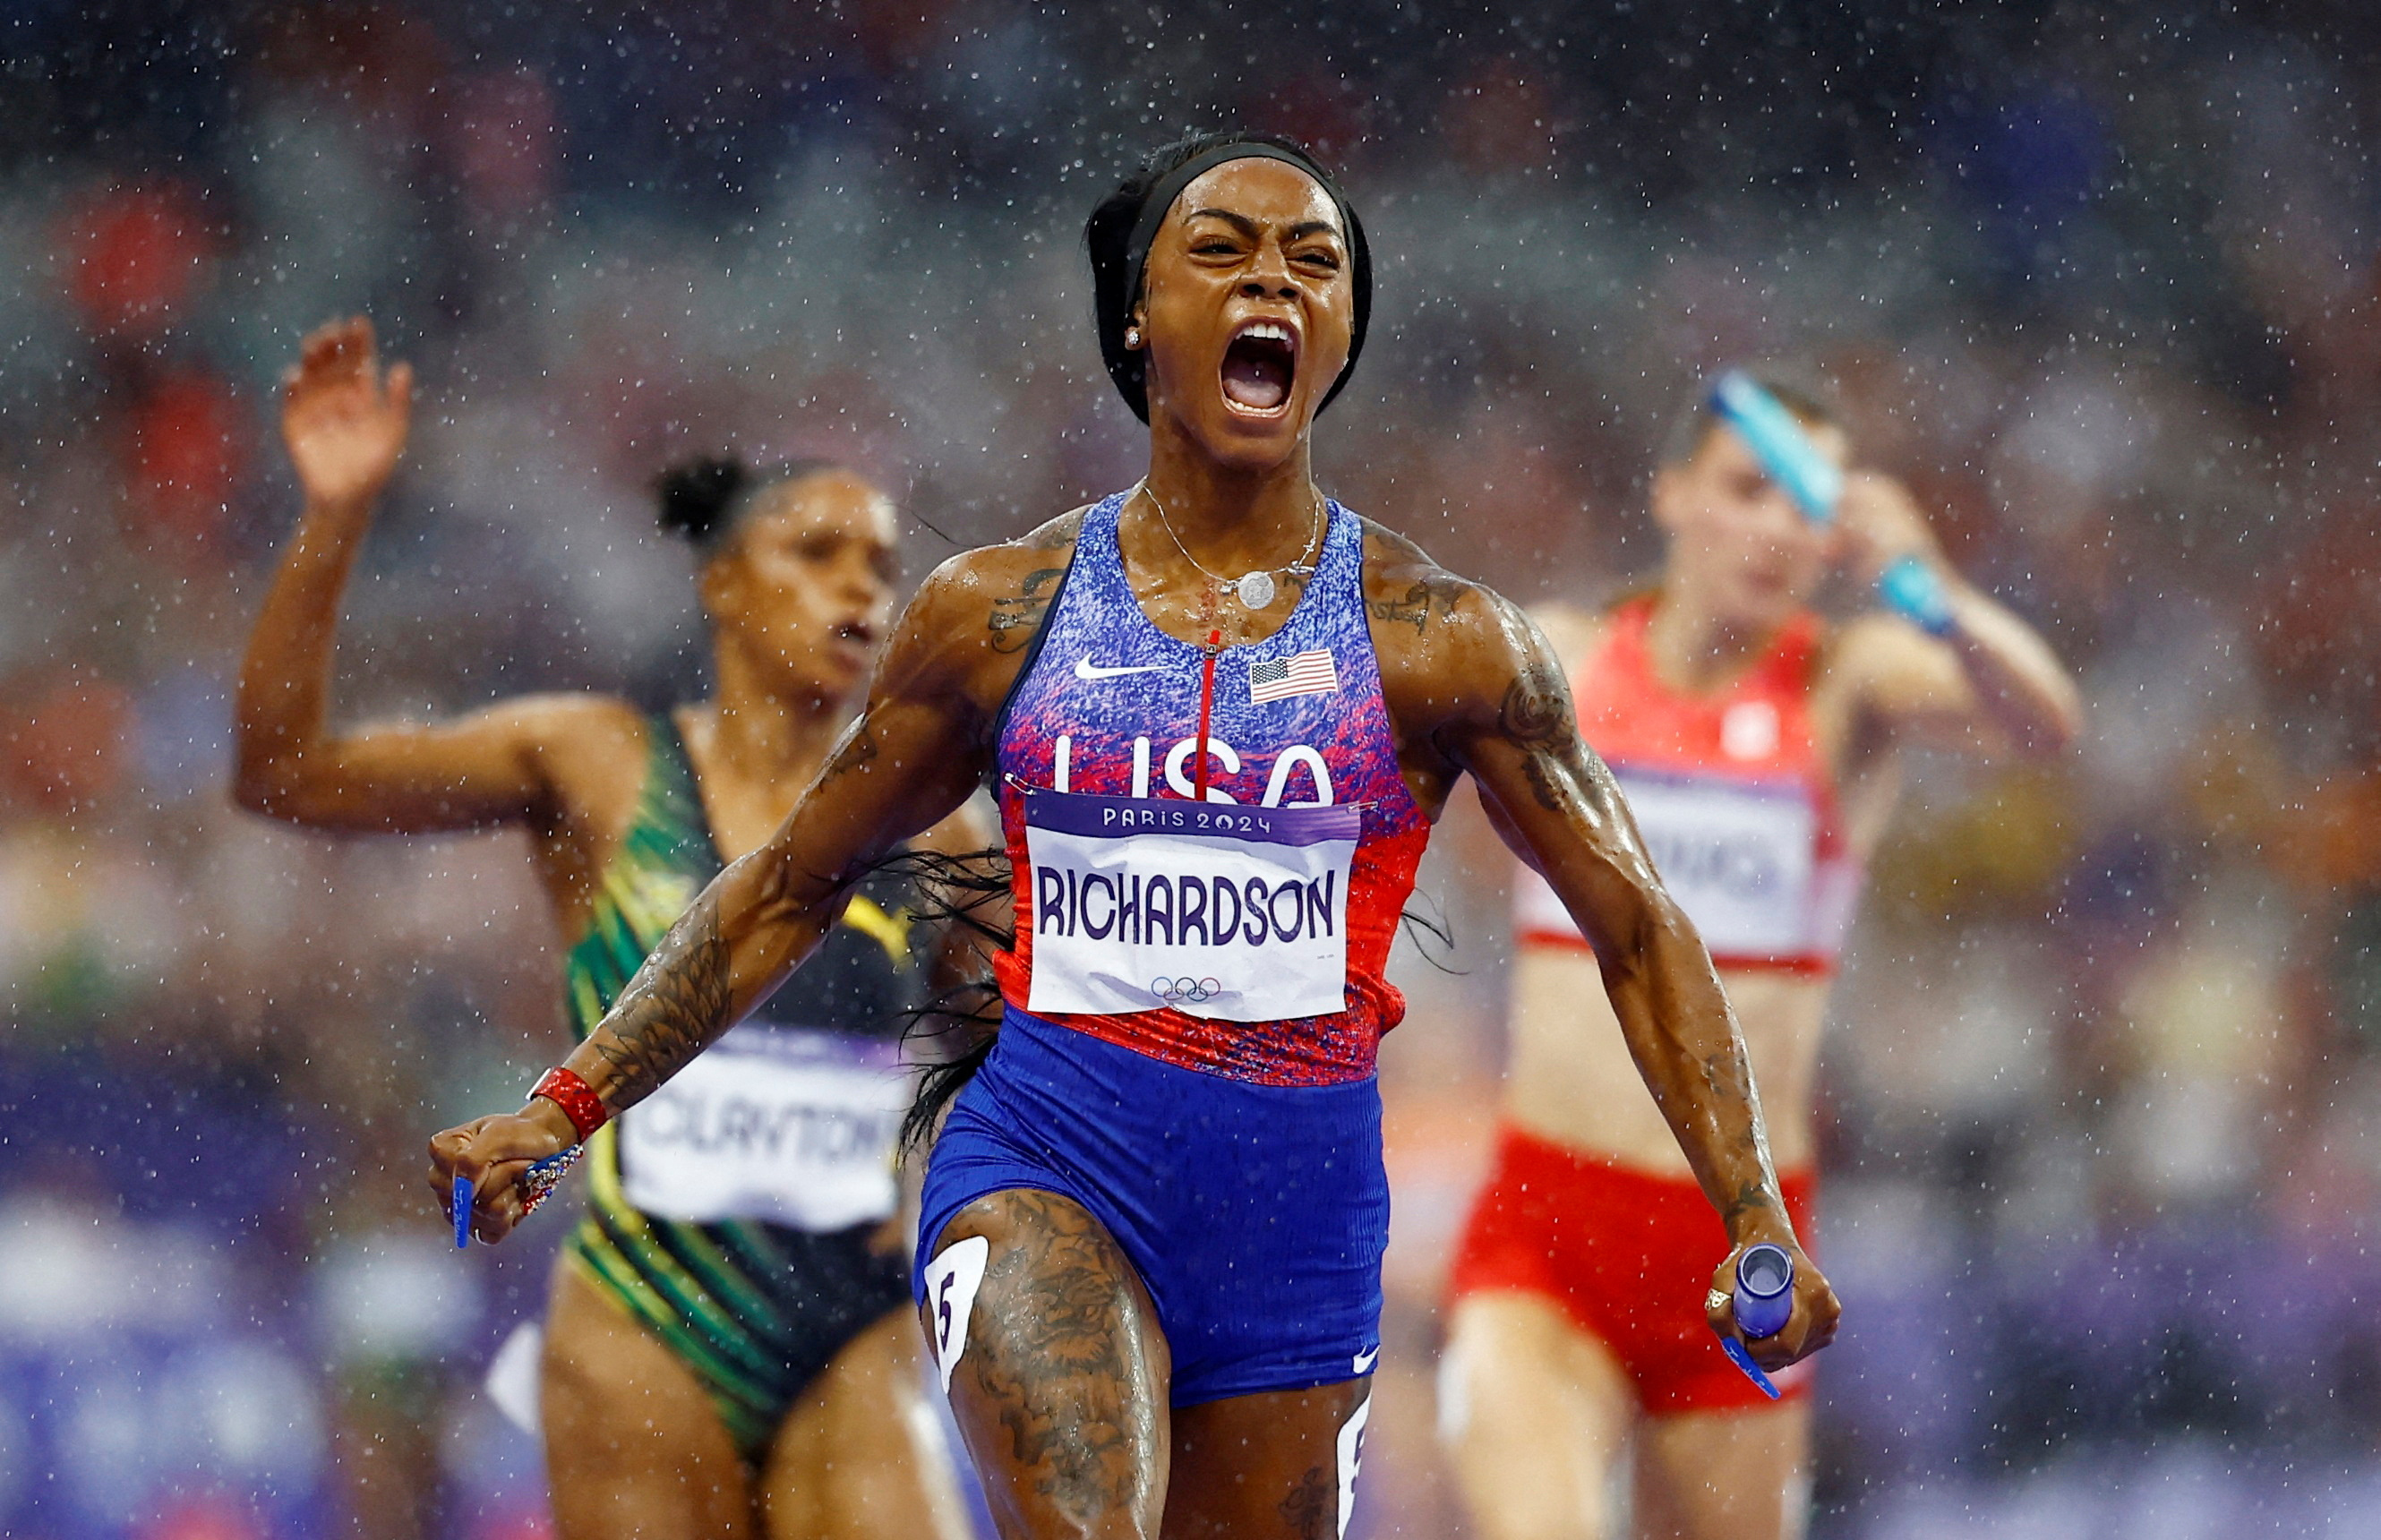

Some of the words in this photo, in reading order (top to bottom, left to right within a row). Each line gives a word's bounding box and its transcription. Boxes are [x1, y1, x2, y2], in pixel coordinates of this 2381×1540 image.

[1196, 813, 1271, 834] 2024
[1037, 866, 1336, 946] RICHARDSON
[938, 1270, 955, 1354] 5
